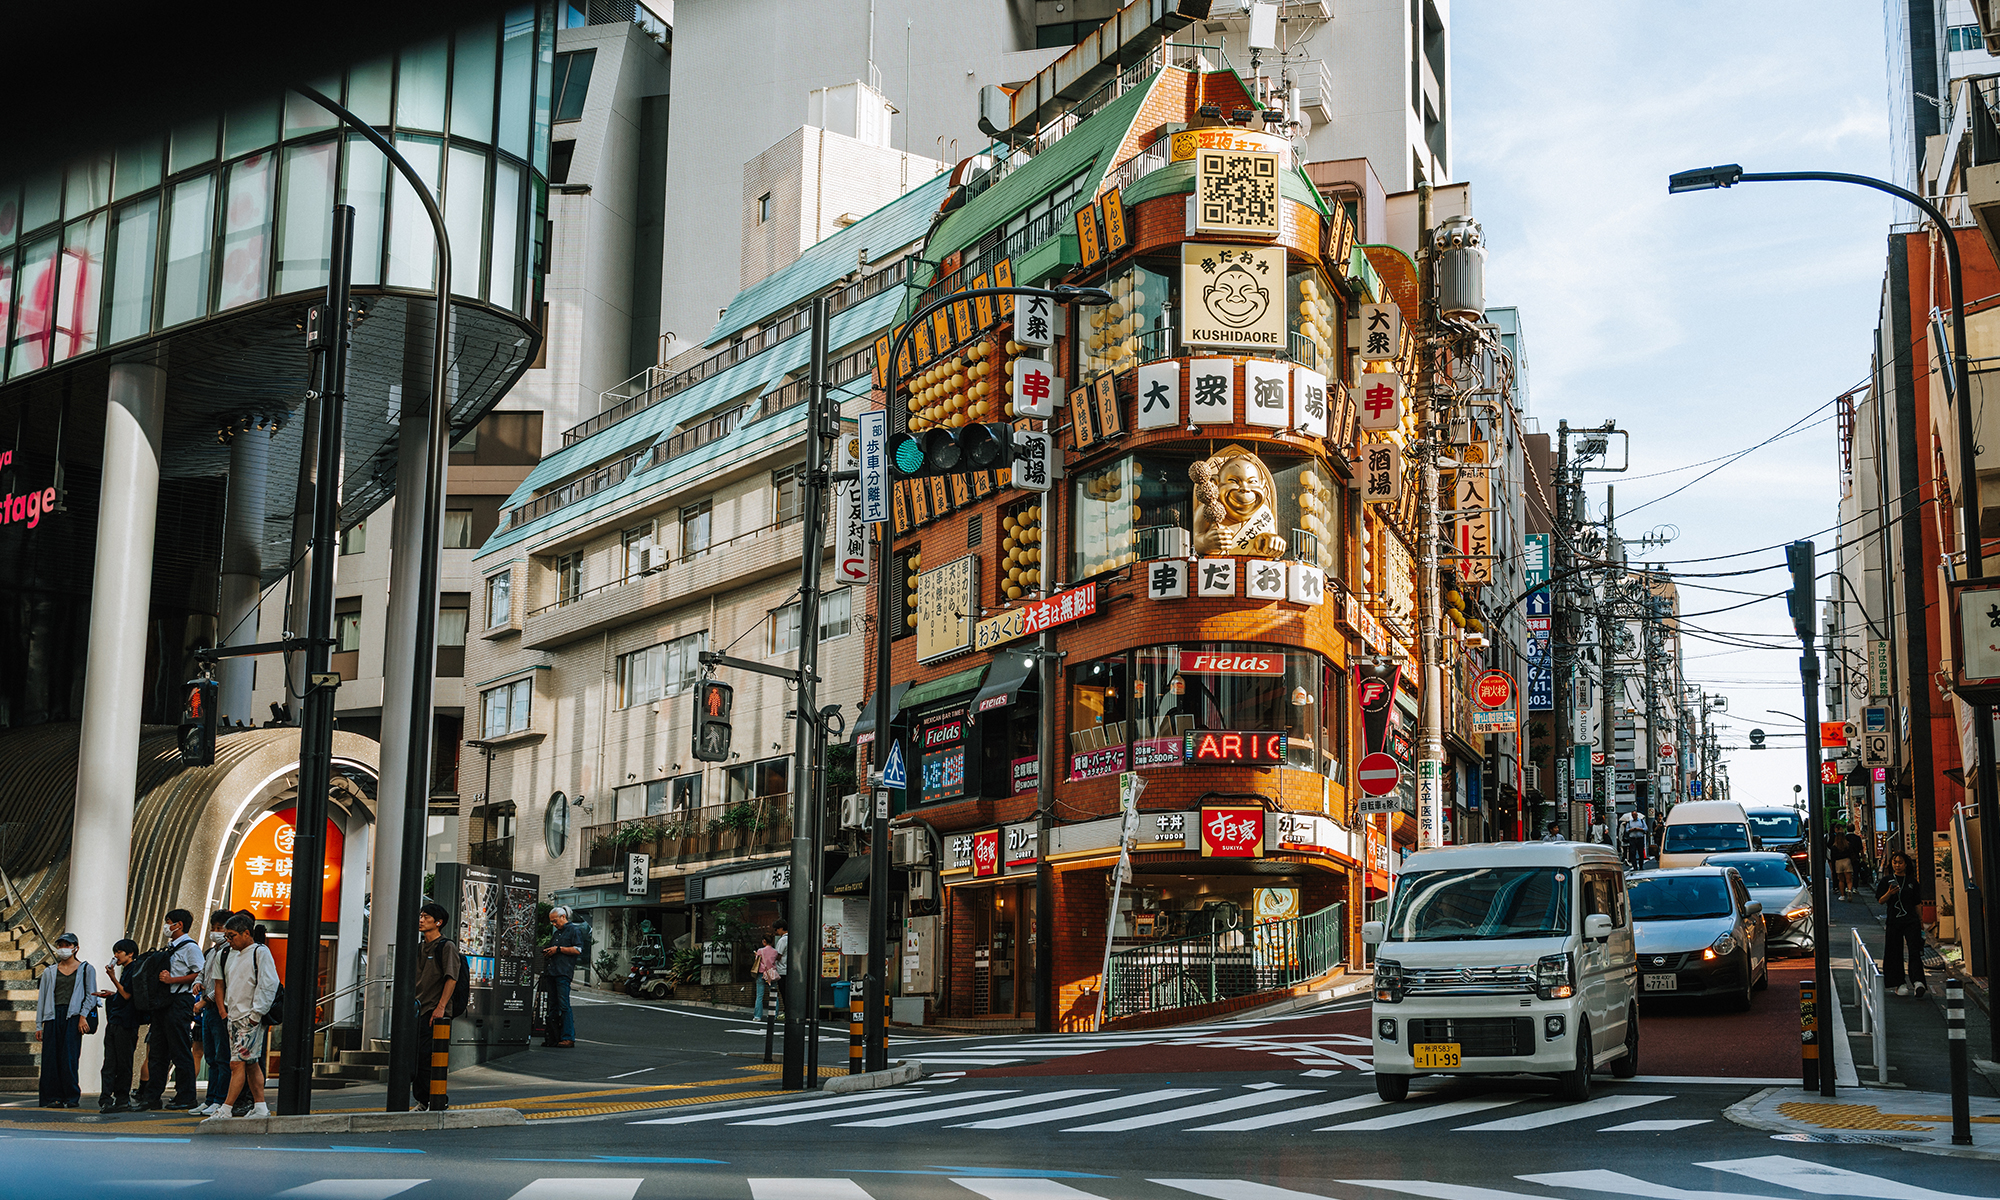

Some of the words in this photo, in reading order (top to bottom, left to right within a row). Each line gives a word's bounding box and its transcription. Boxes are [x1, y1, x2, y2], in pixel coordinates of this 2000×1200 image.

[1082, 211, 1096, 261] おでん
[1200, 250, 1270, 275] 串だおれ
[1027, 296, 1048, 341] 大衆
[1367, 309, 1391, 354] 大衆
[1192, 329, 1278, 343] KUSHIDAORE
[1023, 369, 1050, 406] 串
[1101, 380, 1114, 430] 串カツ
[1364, 382, 1394, 420] 串
[1024, 435, 1047, 485] 酒場
[1368, 448, 1392, 495] 酒場
[0, 487, 56, 529] tage
[978, 612, 1025, 648] おみくじ
[1193, 655, 1271, 671] Fields
[1481, 684, 1507, 697] 消火栓
[926, 725, 960, 745] Fields
[1360, 799, 1399, 811] 自転車を除く
[1420, 780, 1432, 830] 大平医院
[1156, 815, 1184, 831] 牛丼
[1208, 812, 1257, 844] すき家
[1278, 817, 1312, 832] カレー
[952, 836, 972, 858] 牛丼
[976, 836, 996, 863] すき家
[1009, 829, 1037, 850] カレー
[1155, 833, 1184, 841] GYUDON
[1651, 980, 1675, 989] 77-11
[1426, 1053, 1459, 1066] 11-99
